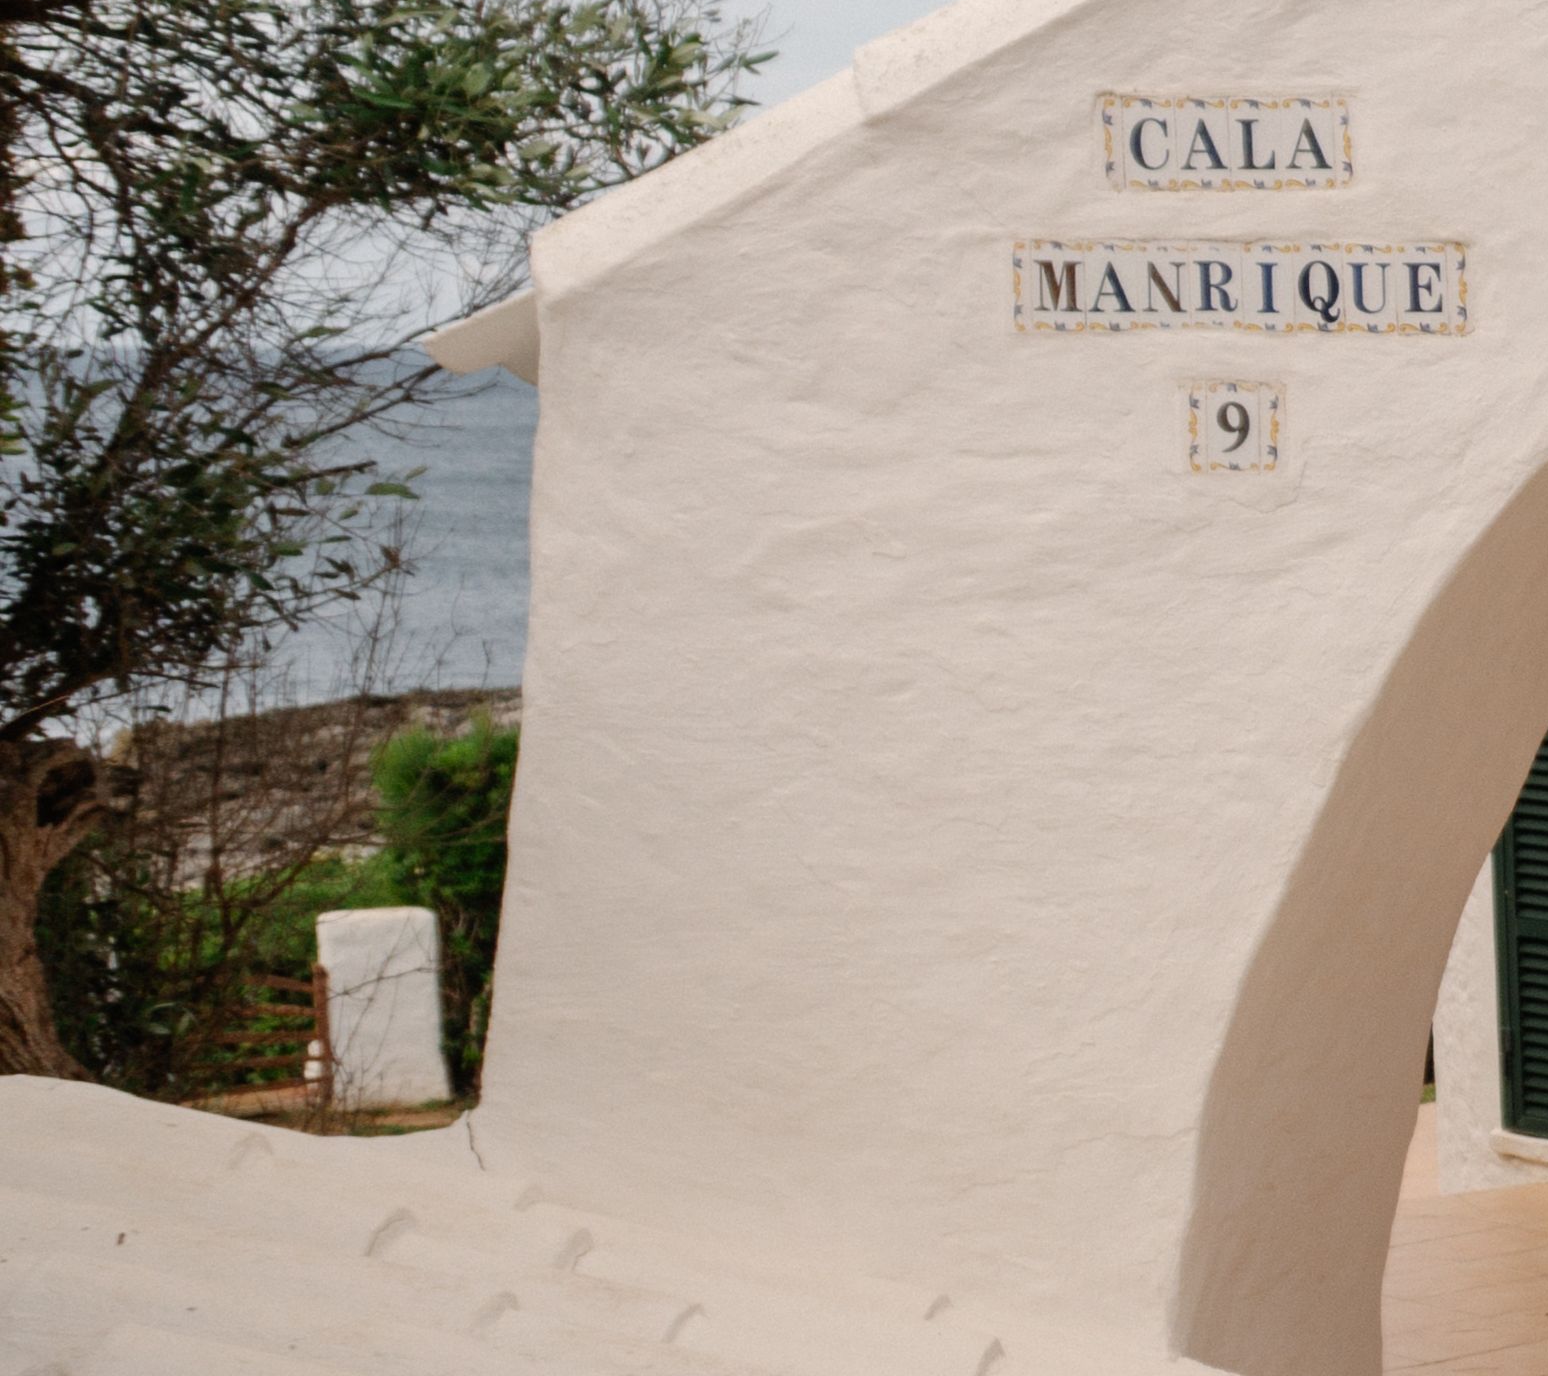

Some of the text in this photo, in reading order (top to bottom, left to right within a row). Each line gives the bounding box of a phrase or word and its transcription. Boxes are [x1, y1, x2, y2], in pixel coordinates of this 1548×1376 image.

[1128, 117, 1333, 171] CALA
[1033, 259, 1444, 323] MANRIQUE
[1215, 400, 1251, 453] 9
